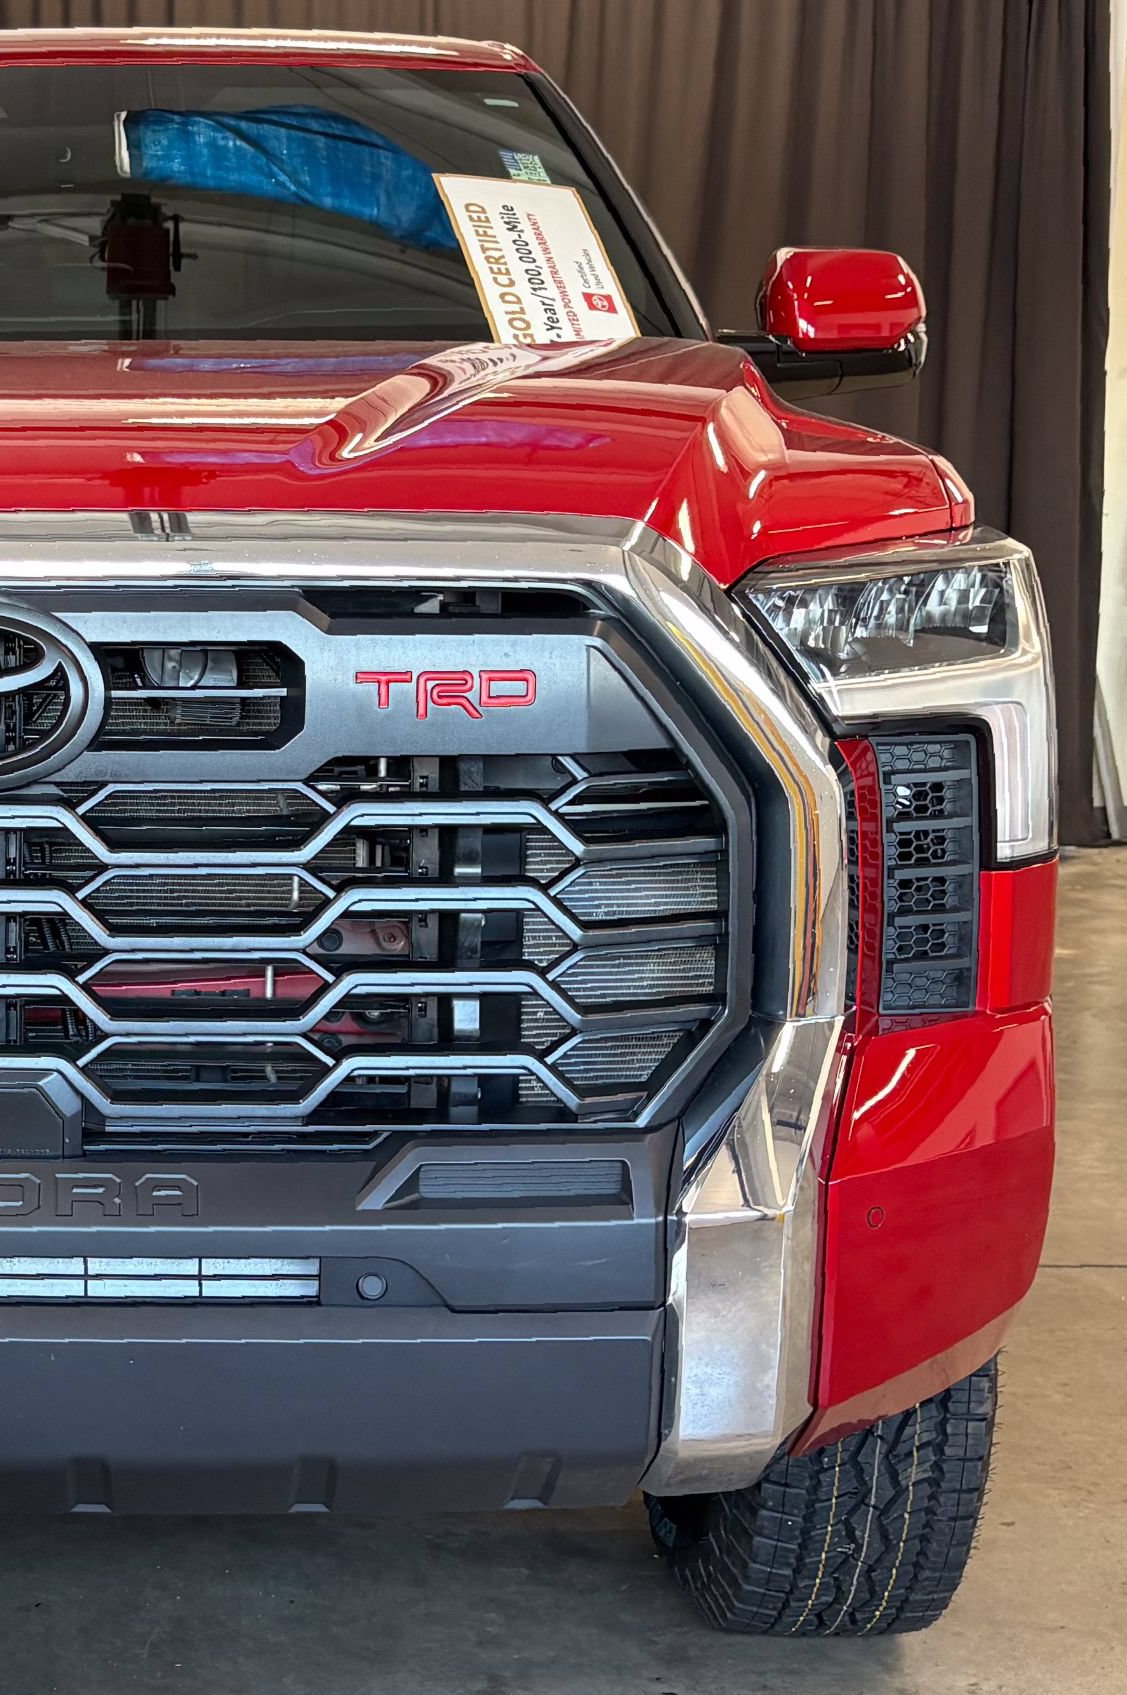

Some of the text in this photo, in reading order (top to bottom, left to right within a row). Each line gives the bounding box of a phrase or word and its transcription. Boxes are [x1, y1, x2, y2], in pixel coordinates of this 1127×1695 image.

[464, 202, 516, 288] CERTIFIED
[525, 212, 553, 257] WARRANTY
[499, 204, 563, 344] -Year/100,000-Mile
[545, 256, 574, 309] POWERTRAIN
[498, 291, 537, 345] GOLD
[566, 309, 585, 340] IMITED
[355, 668, 538, 720] TRD
